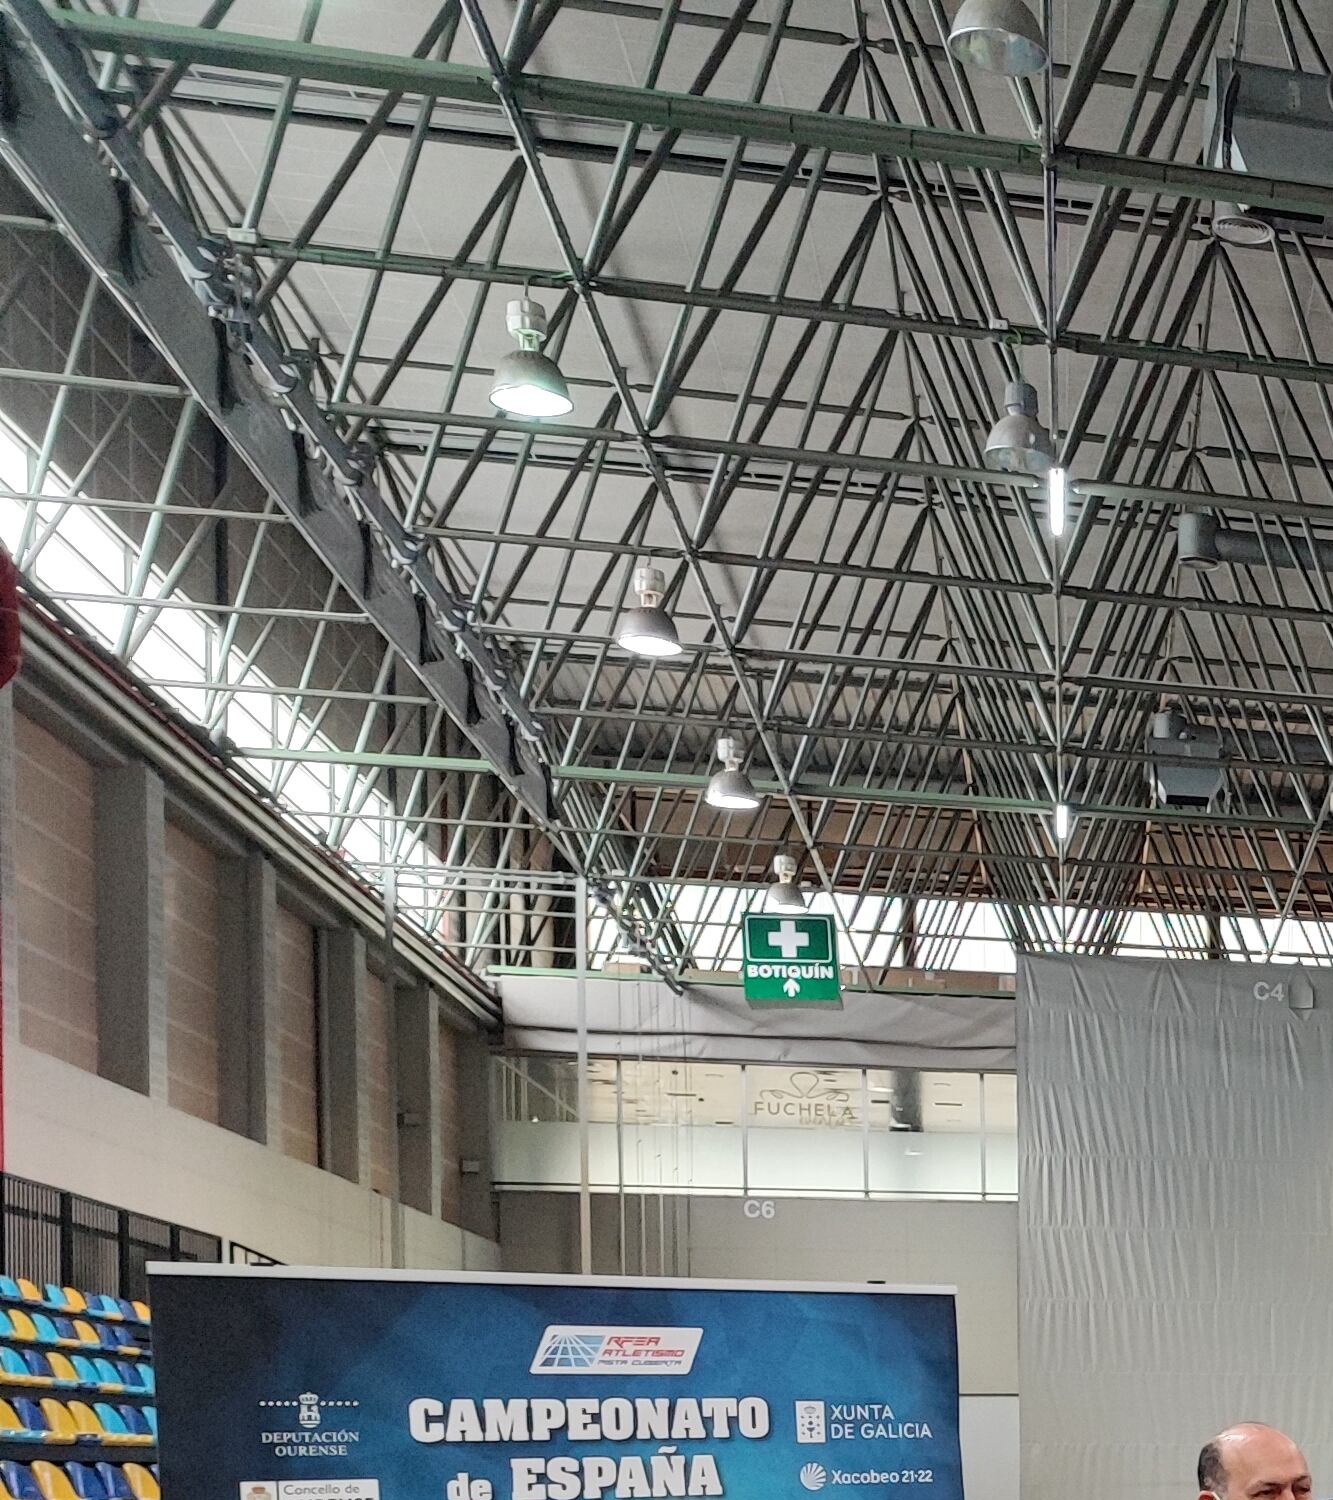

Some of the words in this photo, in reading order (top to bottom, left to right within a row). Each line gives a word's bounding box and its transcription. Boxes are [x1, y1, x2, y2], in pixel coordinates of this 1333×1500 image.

[747, 962, 834, 980] BOTIQUÍN
[1253, 981, 1285, 1001] C4
[754, 1101, 854, 1119] FUCHELA
[744, 1200, 775, 1219] C6
[607, 1336, 661, 1348] RFEA
[602, 1350, 685, 1358] ATLETISMO
[831, 1404, 895, 1420] XUNTA
[409, 1398, 770, 1443] CAMPEONATO
[262, 1429, 359, 1443] DEPUTACIÓN
[831, 1424, 855, 1439] DE
[861, 1422, 933, 1439] GALICIA
[275, 1445, 348, 1457] OURENSE
[510, 1446, 723, 1500] ESPAÑA
[832, 1470, 899, 1485] Xacobeo
[284, 1484, 340, 1495] Concello
[345, 1484, 360, 1494] de
